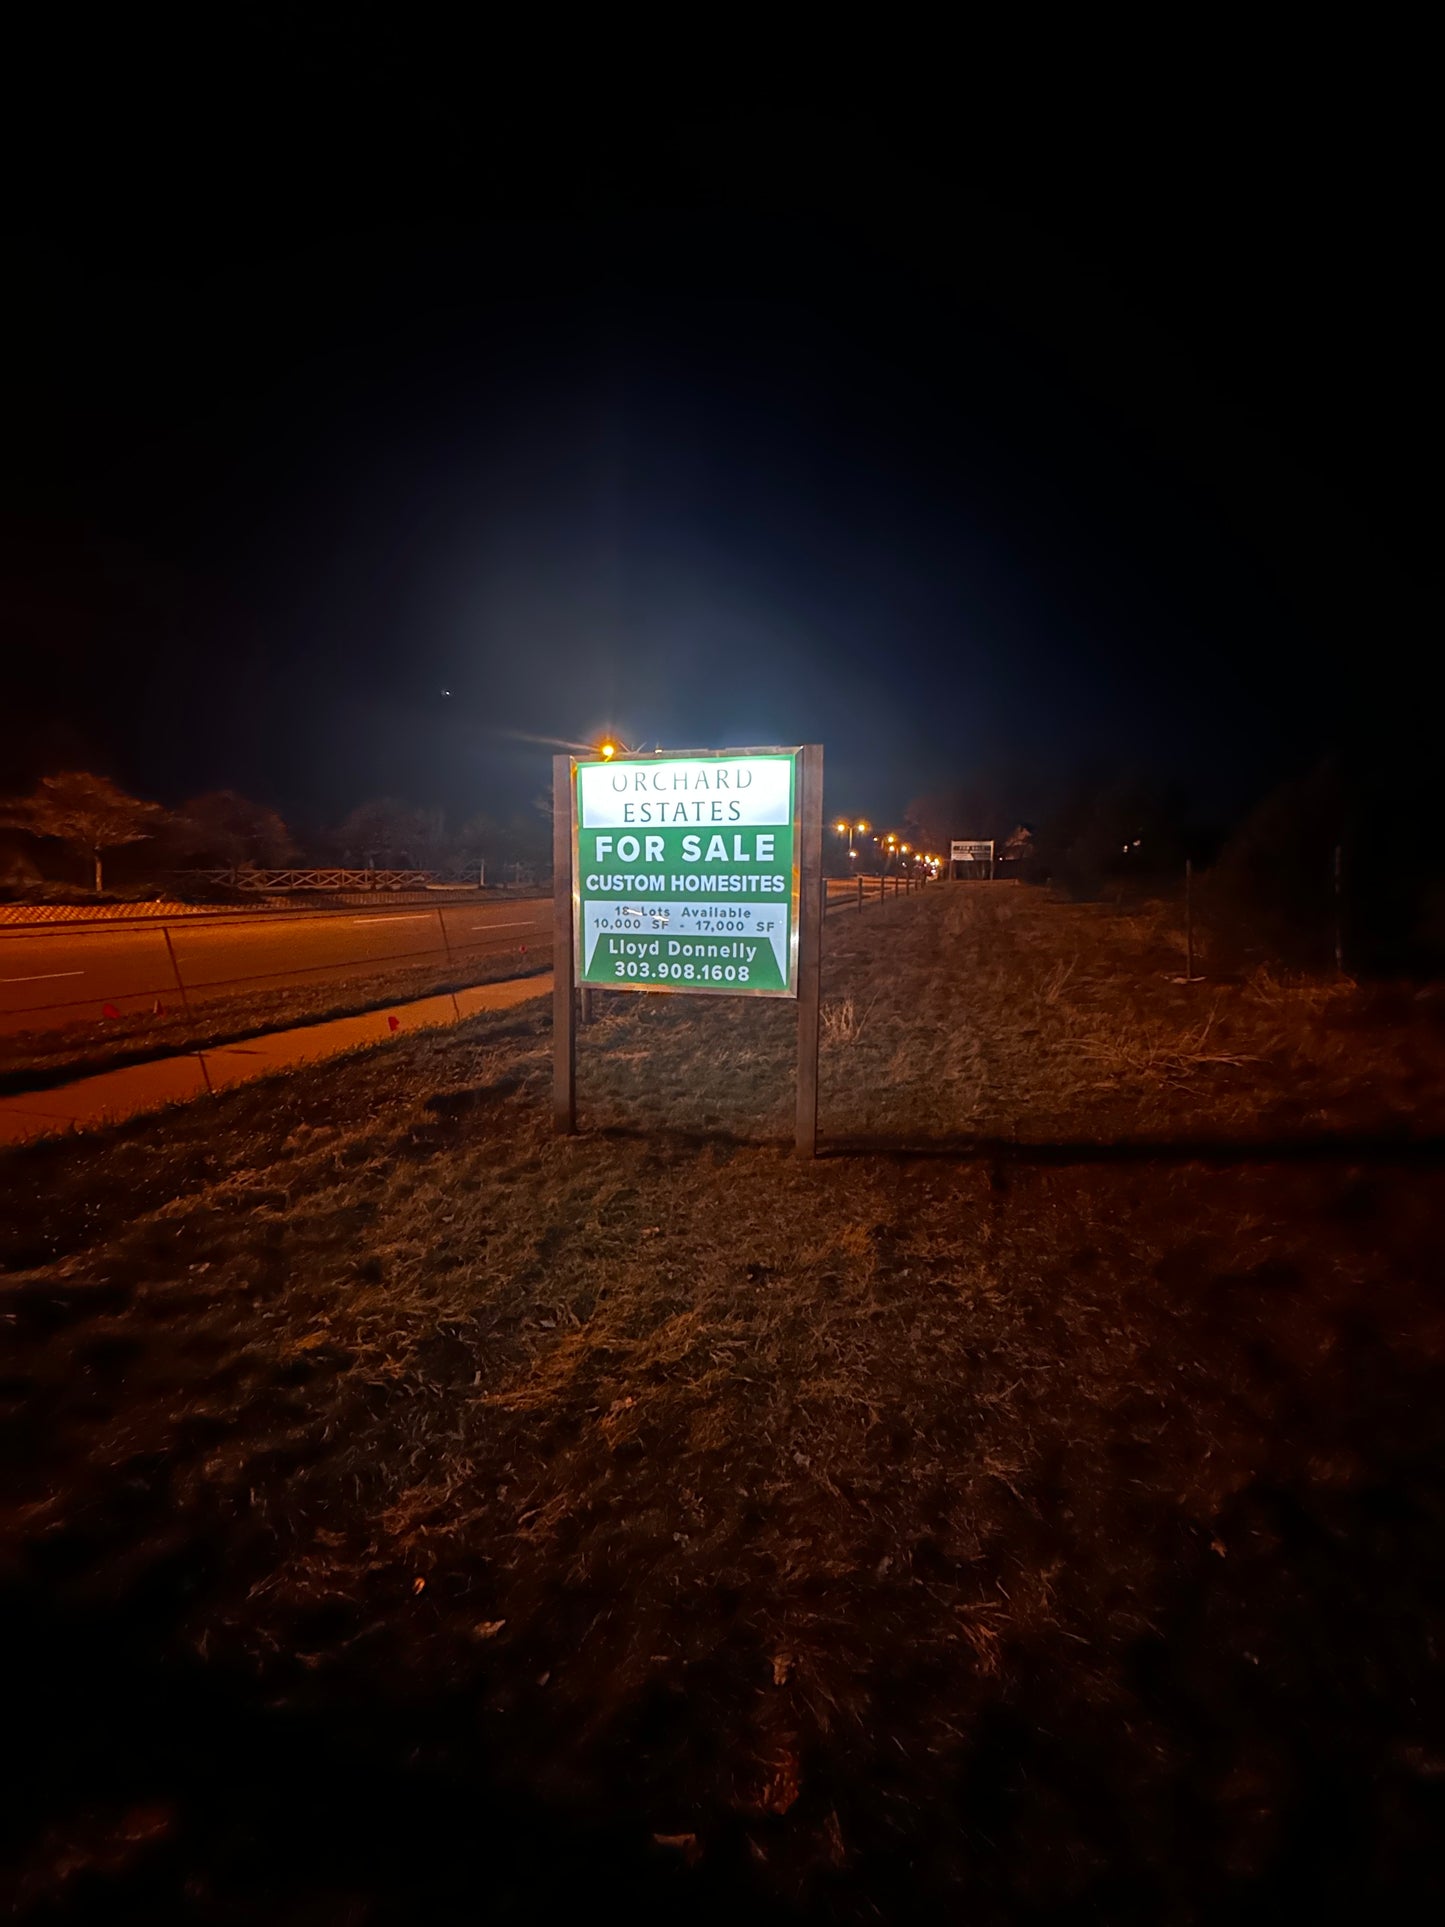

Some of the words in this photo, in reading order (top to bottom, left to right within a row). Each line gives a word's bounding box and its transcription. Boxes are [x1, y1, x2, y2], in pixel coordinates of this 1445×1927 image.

[613, 769, 752, 792] ORCHARD
[624, 800, 741, 822] ESTATES
[596, 835, 665, 862] FOR
[682, 834, 775, 862] SALE
[586, 874, 664, 891] CUSTOM
[671, 875, 785, 892] HOMESITES
[641, 907, 670, 917] Lots
[682, 908, 751, 918] Available
[594, 919, 641, 931] 10,000
[652, 920, 669, 929] SF
[696, 921, 744, 932] 17,000
[756, 922, 774, 932] SF
[609, 939, 660, 958] Lloyd
[668, 940, 757, 960] Donnelly
[615, 962, 749, 981] 303.908.1608
